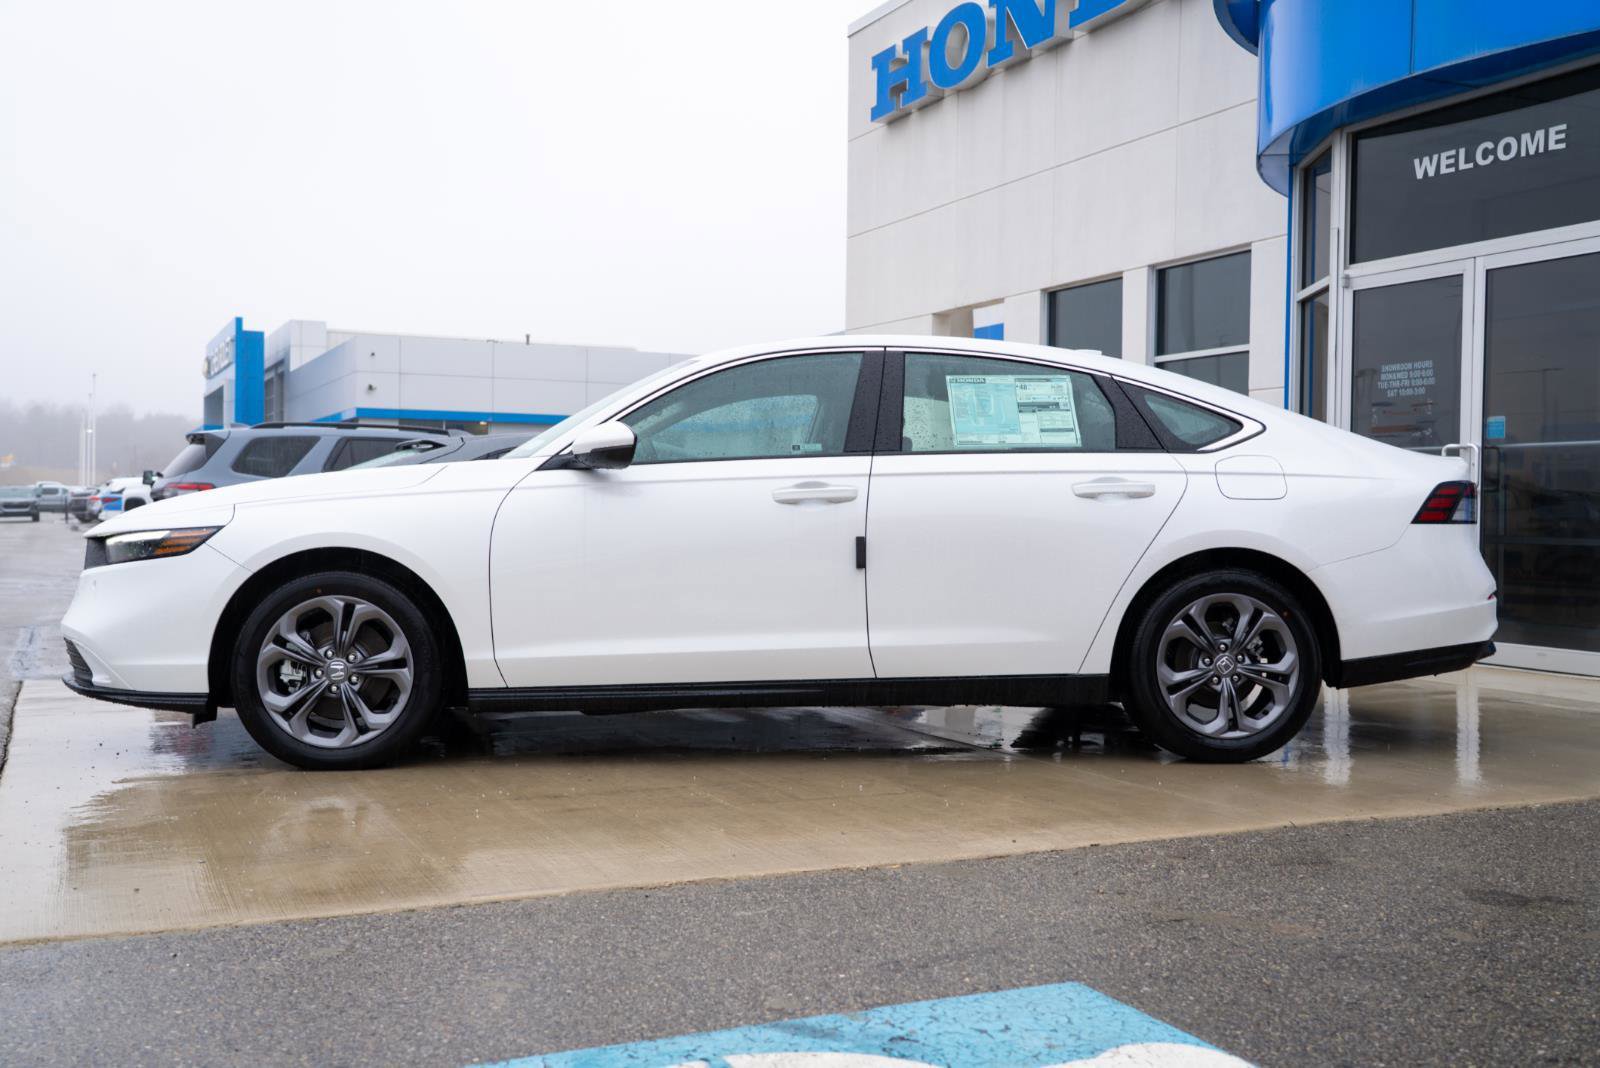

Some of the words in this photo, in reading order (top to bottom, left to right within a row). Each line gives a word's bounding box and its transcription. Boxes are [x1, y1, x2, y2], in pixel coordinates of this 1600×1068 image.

[1413, 123, 1568, 180] WELCOME
[1381, 362, 1413, 373] SHOWROOM
[1413, 360, 1433, 369] HOURS
[1387, 388, 1398, 397] SAT
